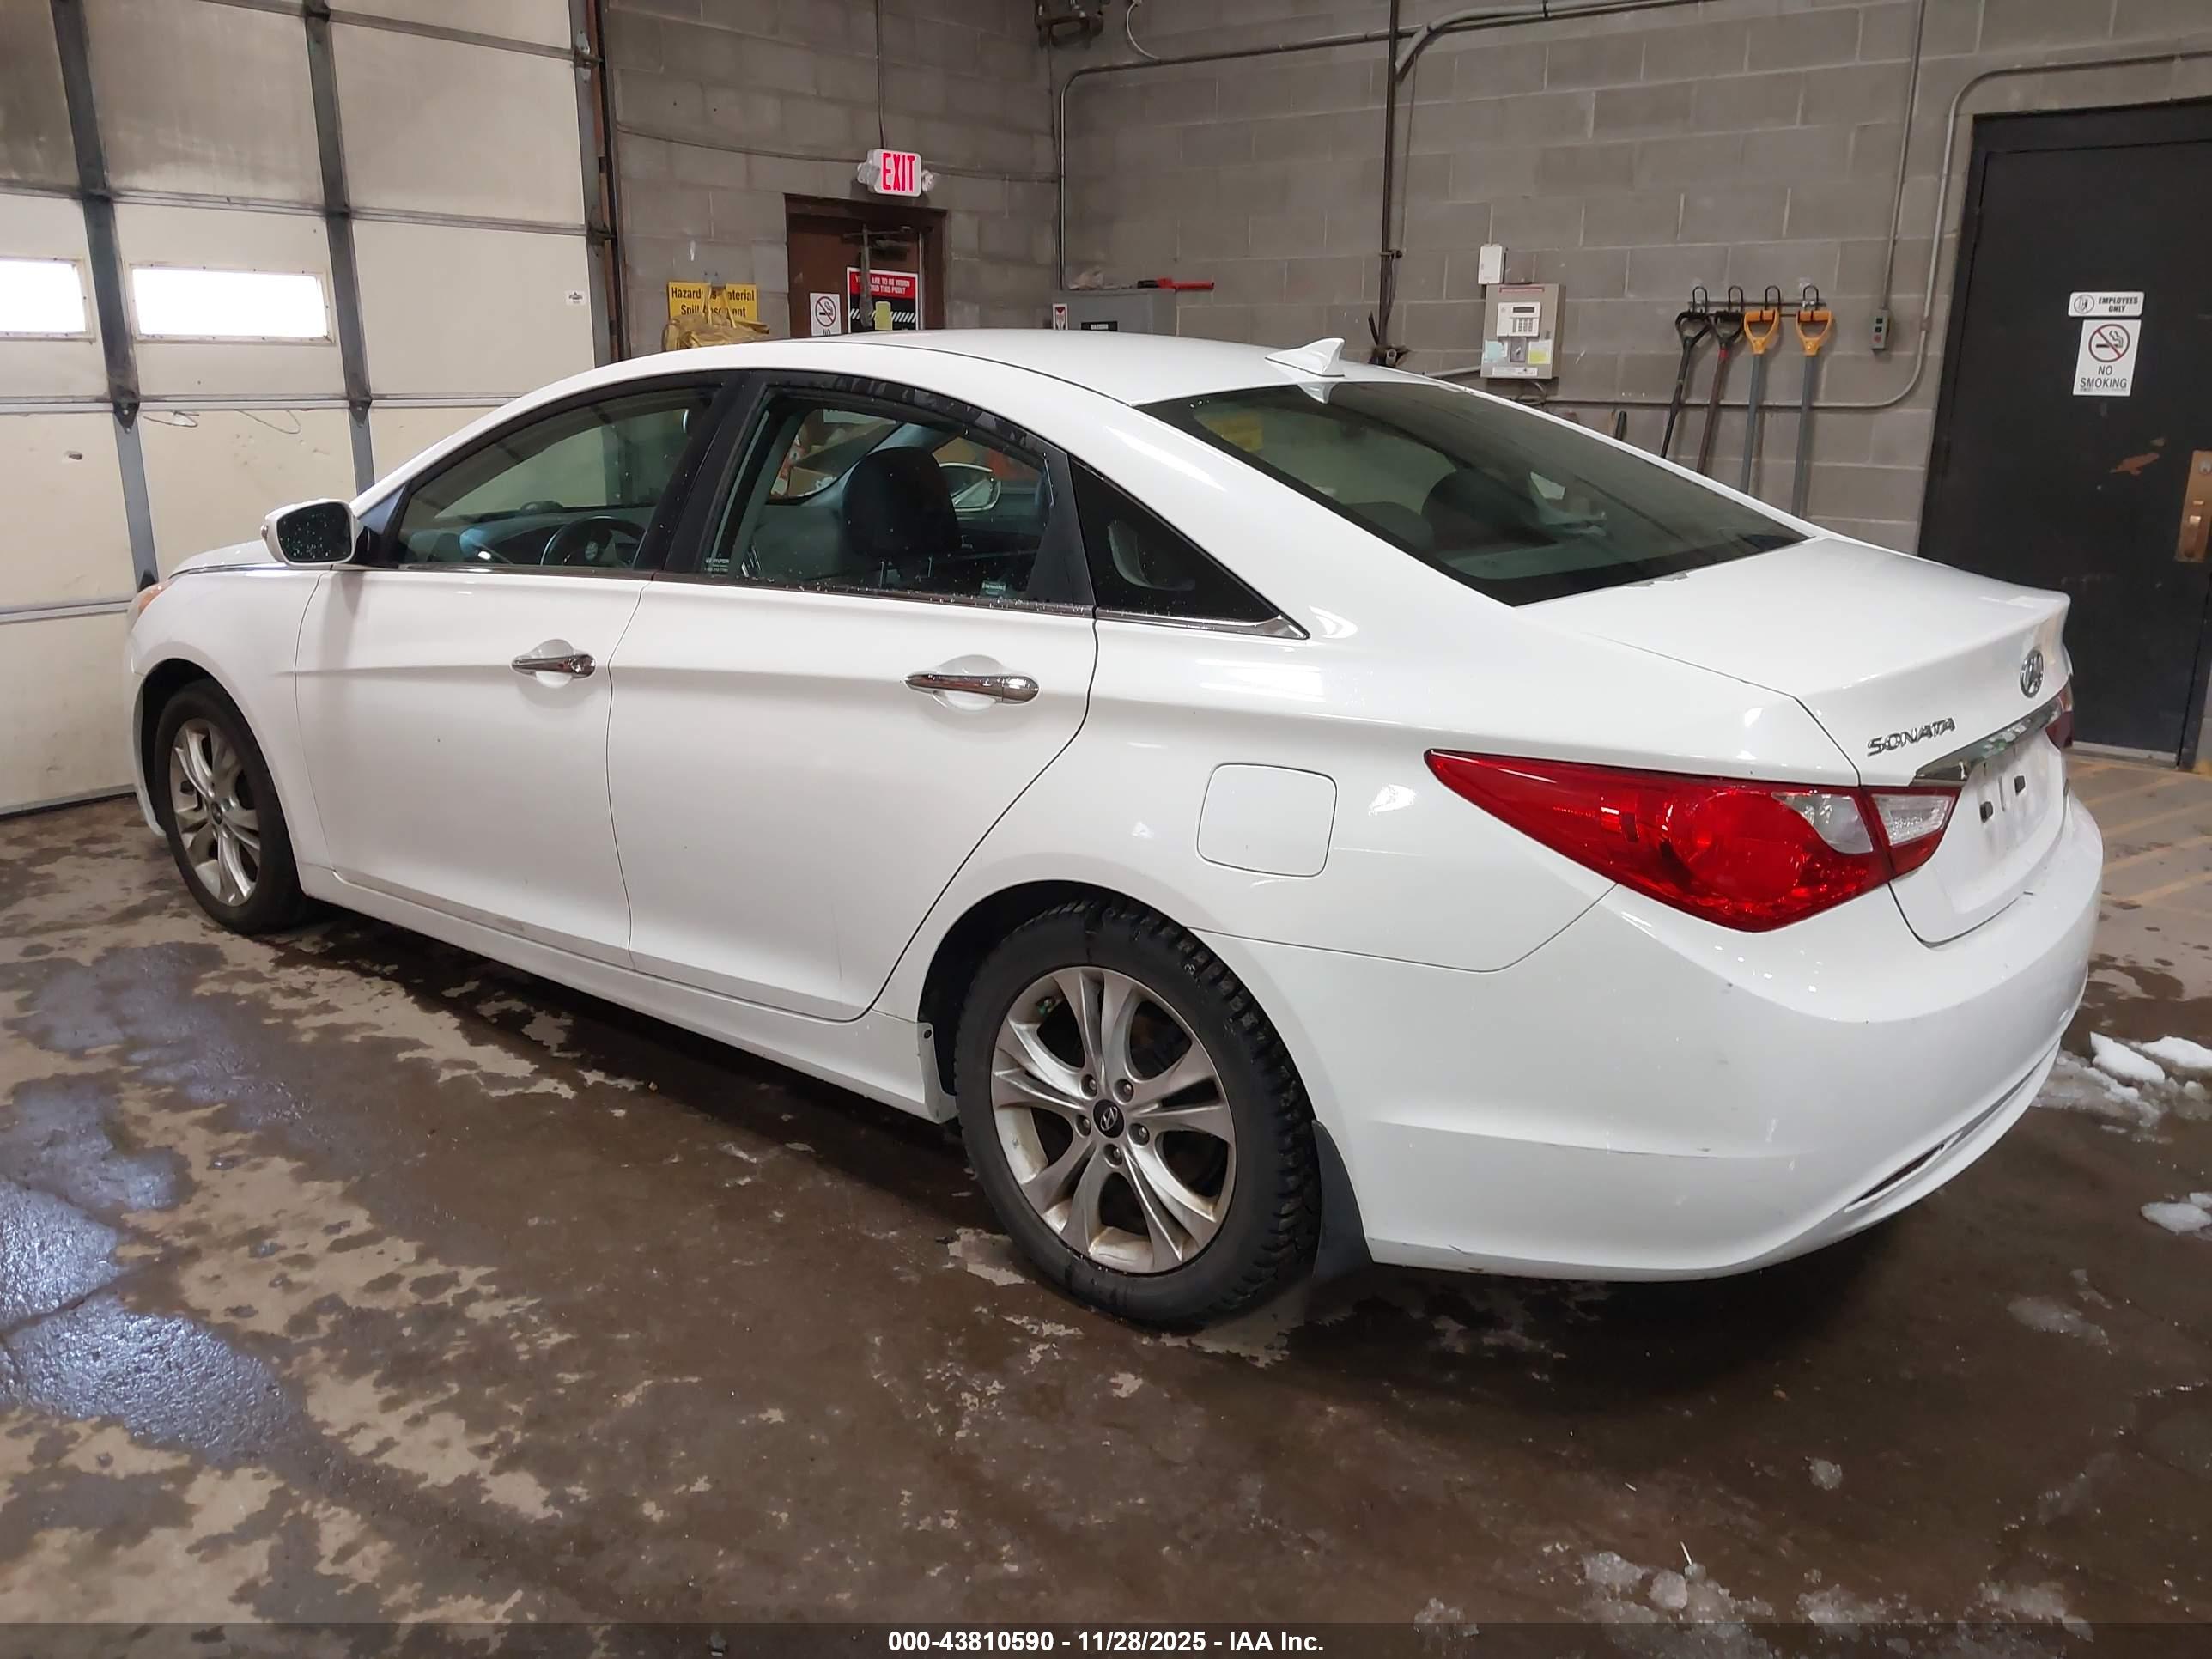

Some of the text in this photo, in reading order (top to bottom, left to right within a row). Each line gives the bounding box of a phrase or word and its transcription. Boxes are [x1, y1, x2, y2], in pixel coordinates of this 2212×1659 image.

[882, 152, 915, 192] EXIT
[723, 289, 755, 301] aterial
[2098, 365, 2112, 376] NO
[2080, 377, 2127, 388] SMOKING
[1868, 717, 1956, 757] SONATA
